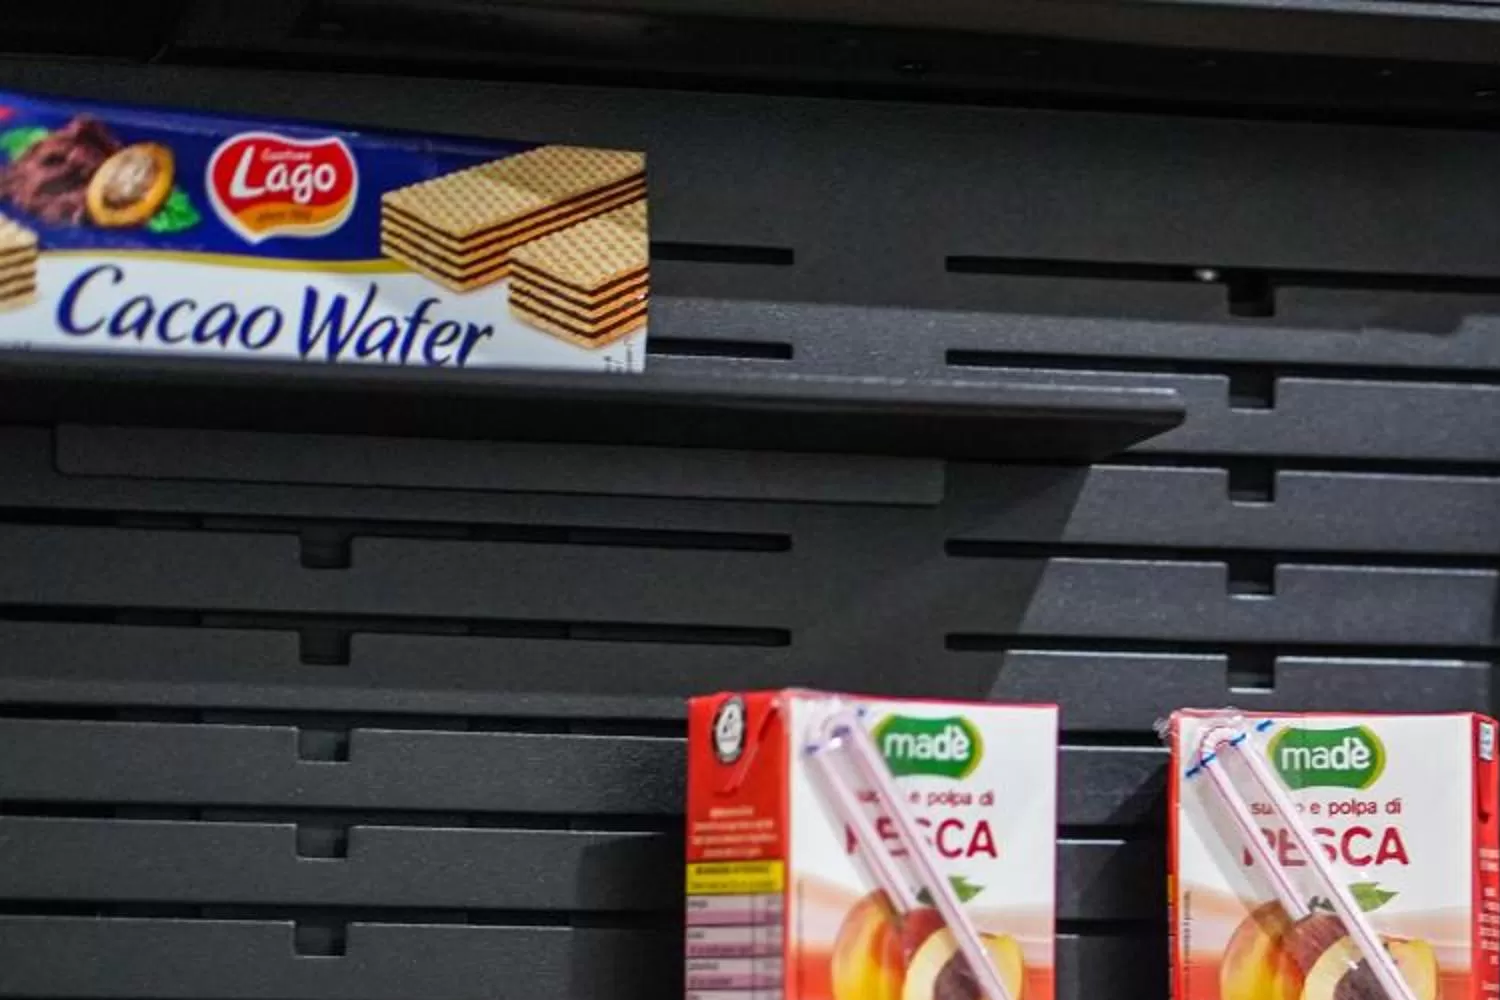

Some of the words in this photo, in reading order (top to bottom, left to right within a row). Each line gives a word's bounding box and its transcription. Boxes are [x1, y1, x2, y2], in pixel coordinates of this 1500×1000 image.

[229, 145, 337, 204] Lago
[55, 264, 283, 350] Cacao
[298, 281, 495, 366] Wafer
[883, 724, 971, 761] madè
[1280, 738, 1371, 770] madè
[927, 789, 972, 807] polpa
[978, 788, 995, 806] di
[1309, 803, 1321, 815] e
[1328, 799, 1377, 816] polpa
[1384, 798, 1403, 815] di
